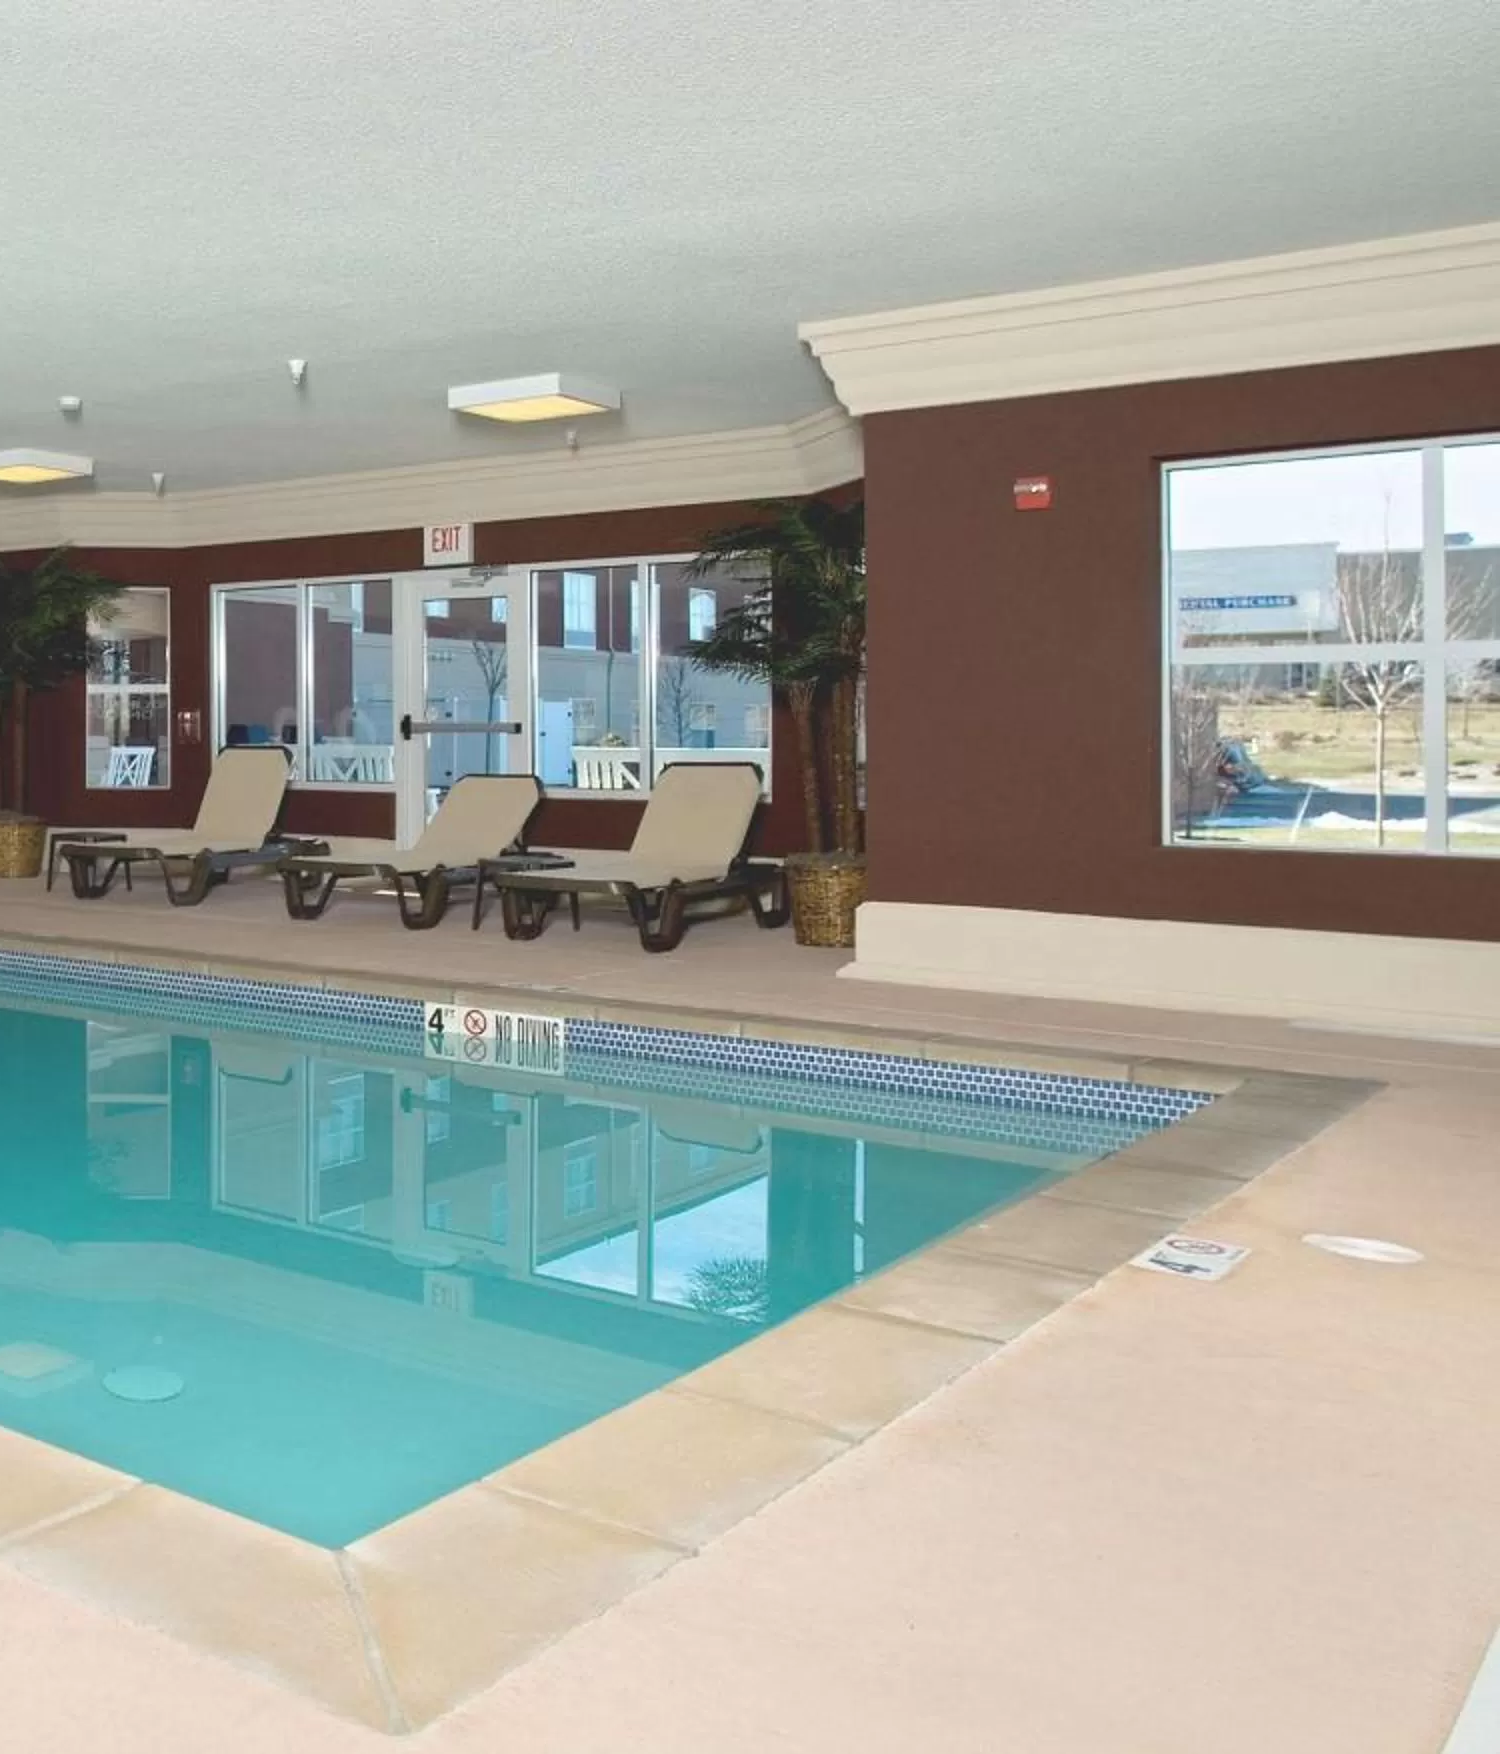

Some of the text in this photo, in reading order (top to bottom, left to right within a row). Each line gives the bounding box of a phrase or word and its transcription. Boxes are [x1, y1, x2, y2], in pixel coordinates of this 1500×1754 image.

[431, 526, 462, 552] EXIT
[428, 1007, 444, 1033] 4
[517, 1017, 560, 1047] DIVING
